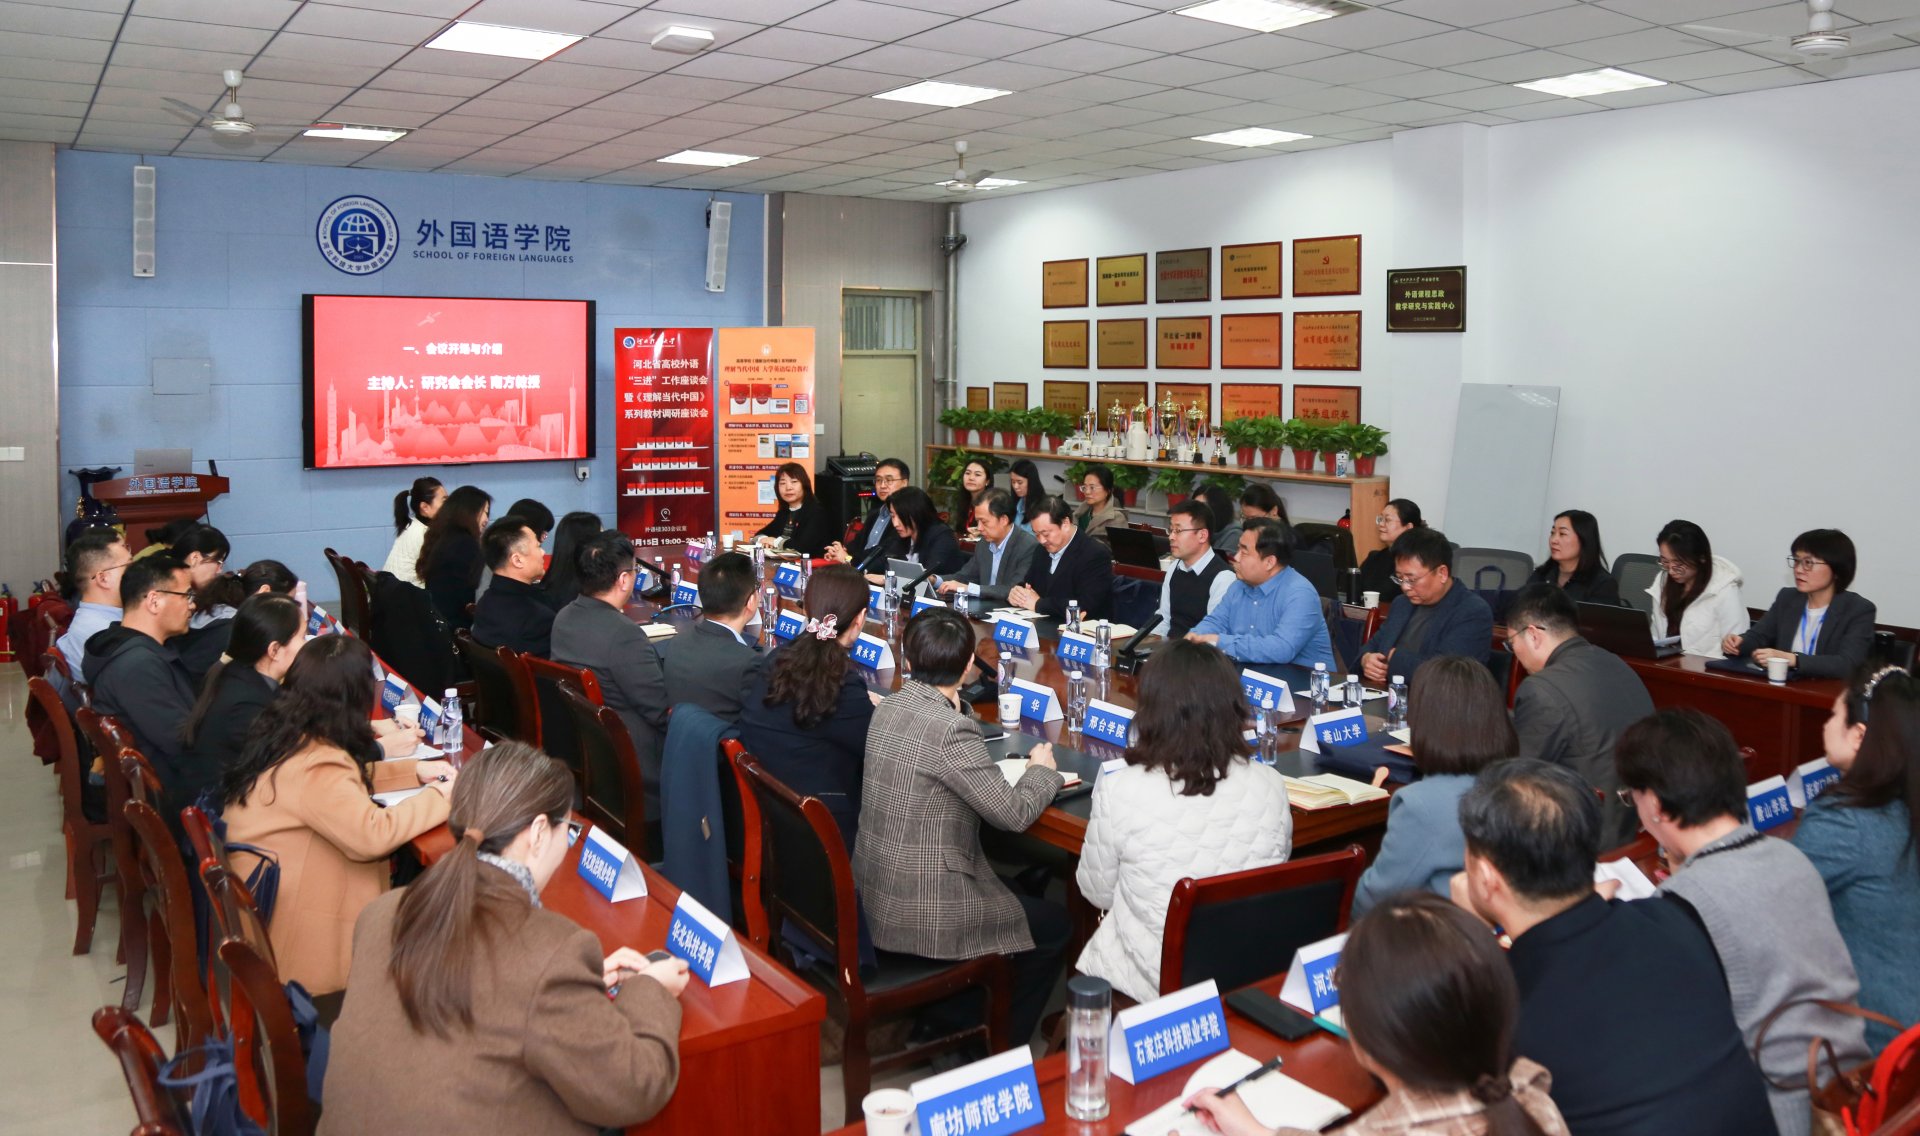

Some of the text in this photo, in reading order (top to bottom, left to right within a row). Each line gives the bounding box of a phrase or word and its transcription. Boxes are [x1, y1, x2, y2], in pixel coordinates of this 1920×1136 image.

[416, 218, 571, 252] 外国语学院
[412, 250, 575, 263] SCHOOL OF FOREIGN LANGUAGES
[1404, 289, 1445, 299] 外语课程思政
[1394, 301, 1456, 311] 教学研究与实践中心
[633, 358, 700, 370] 河北省高校外语
[623, 391, 706, 403] 暨《理解当代中国》
[624, 408, 709, 419] 系列教材调研座谈会
[128, 476, 198, 490] 外国语学院
[1088, 715, 1126, 739] 邢台学院
[1321, 723, 1362, 744] 燕山大学
[671, 917, 716, 972] 华北科技学院
[1133, 1010, 1222, 1067] 石家庄科技职业学院
[929, 1080, 1034, 1136] 廊坊师范学院
